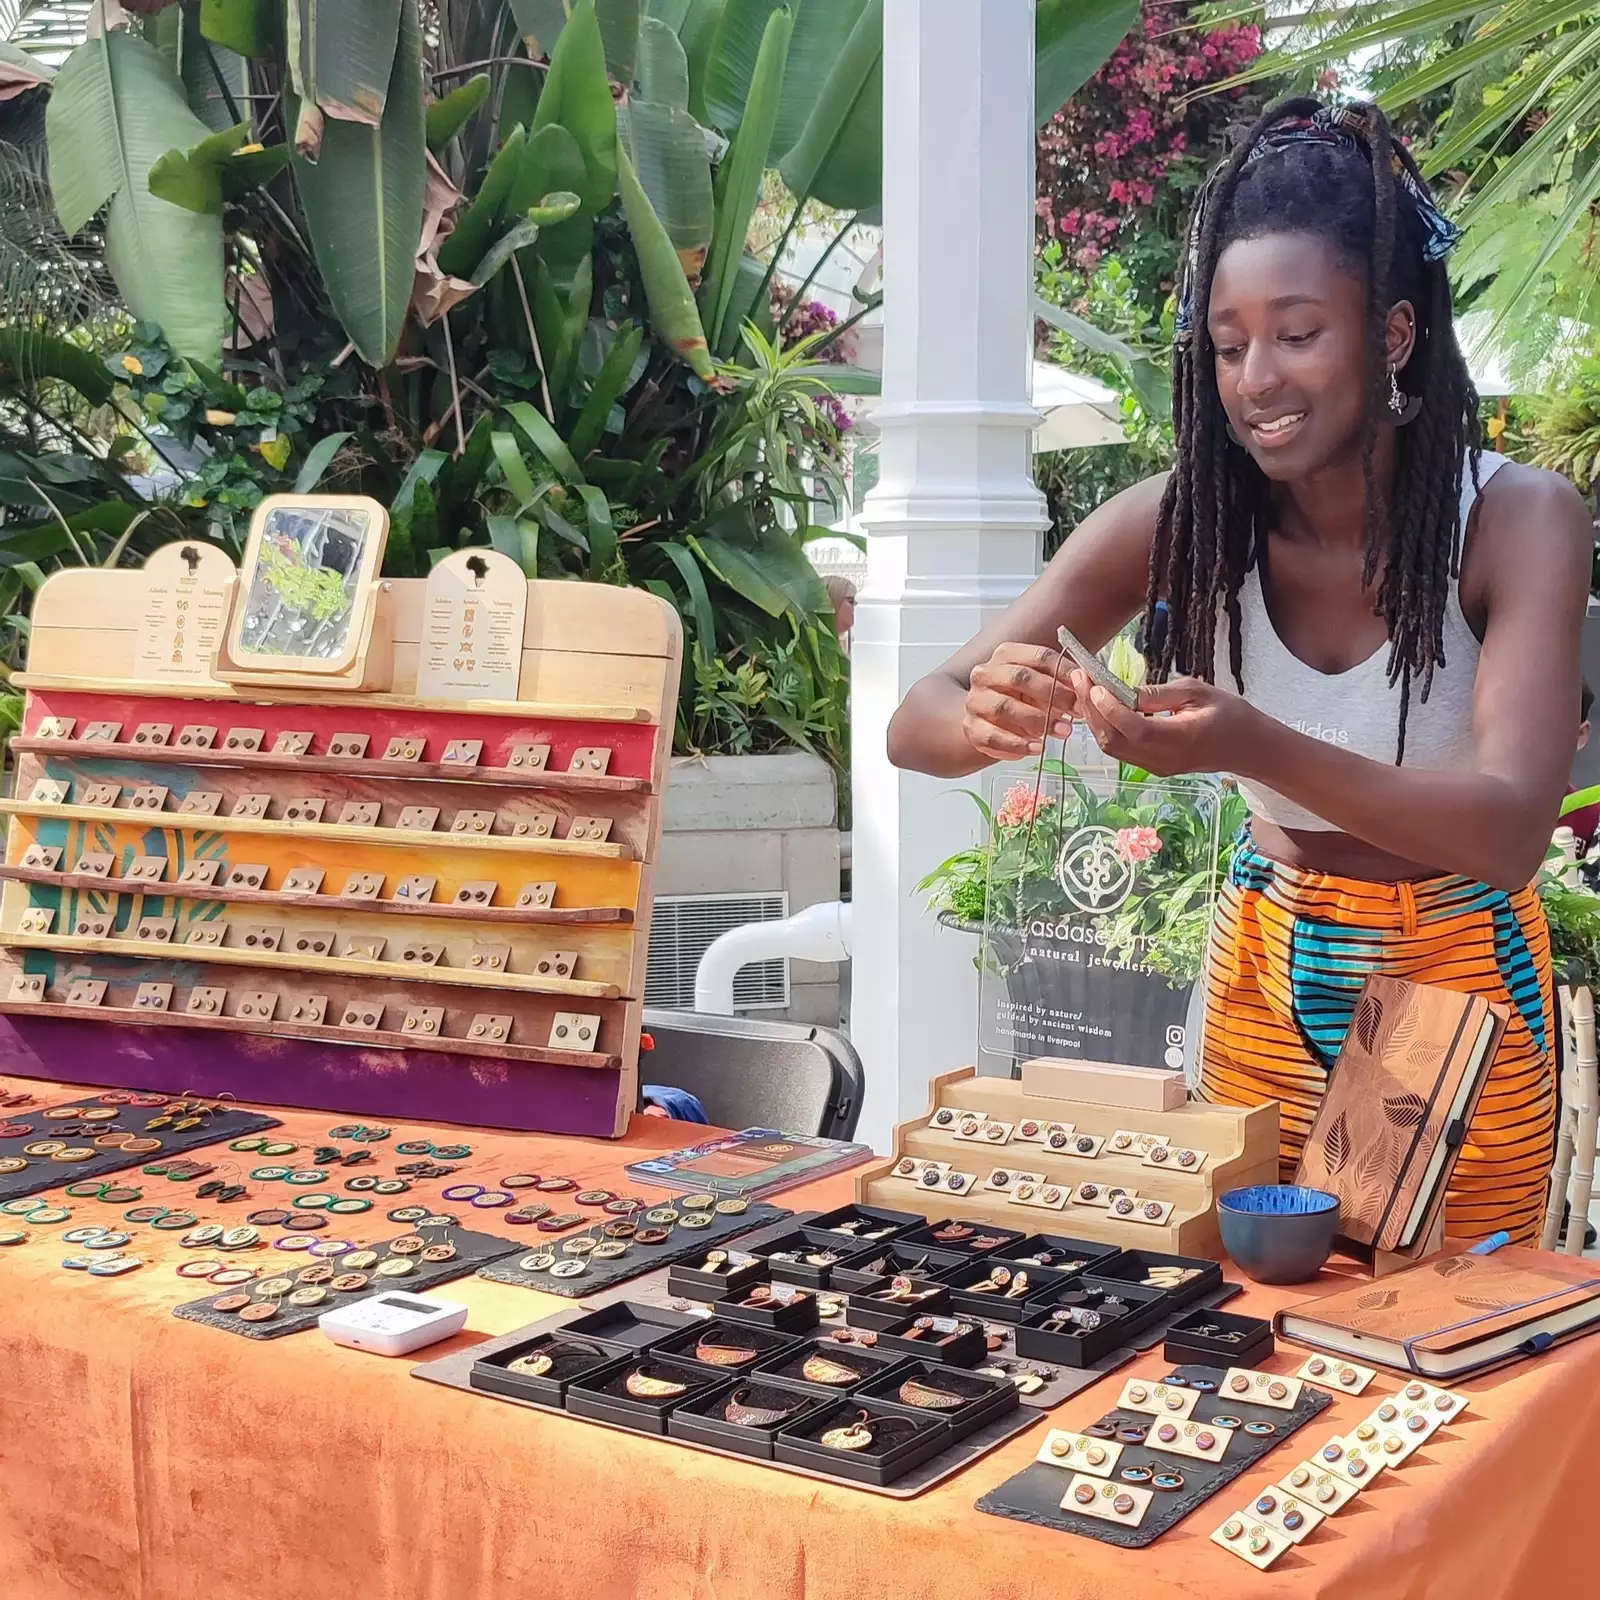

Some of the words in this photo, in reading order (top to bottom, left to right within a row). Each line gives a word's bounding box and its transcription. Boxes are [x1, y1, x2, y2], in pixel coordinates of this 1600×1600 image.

[1282, 719, 1349, 744] didas
[1030, 947, 1080, 963] natural
[1087, 953, 1155, 977] jewellery
[1036, 1005, 1047, 1017] by
[996, 1011, 1026, 1022] guided
[1029, 1015, 1040, 1026] by
[1042, 1019, 1075, 1031] ancient
[1078, 1024, 1112, 1038] wisdom
[996, 1026, 1036, 1040] handmade
[1038, 1033, 1045, 1042] in
[1047, 1035, 1081, 1048] liverpool
